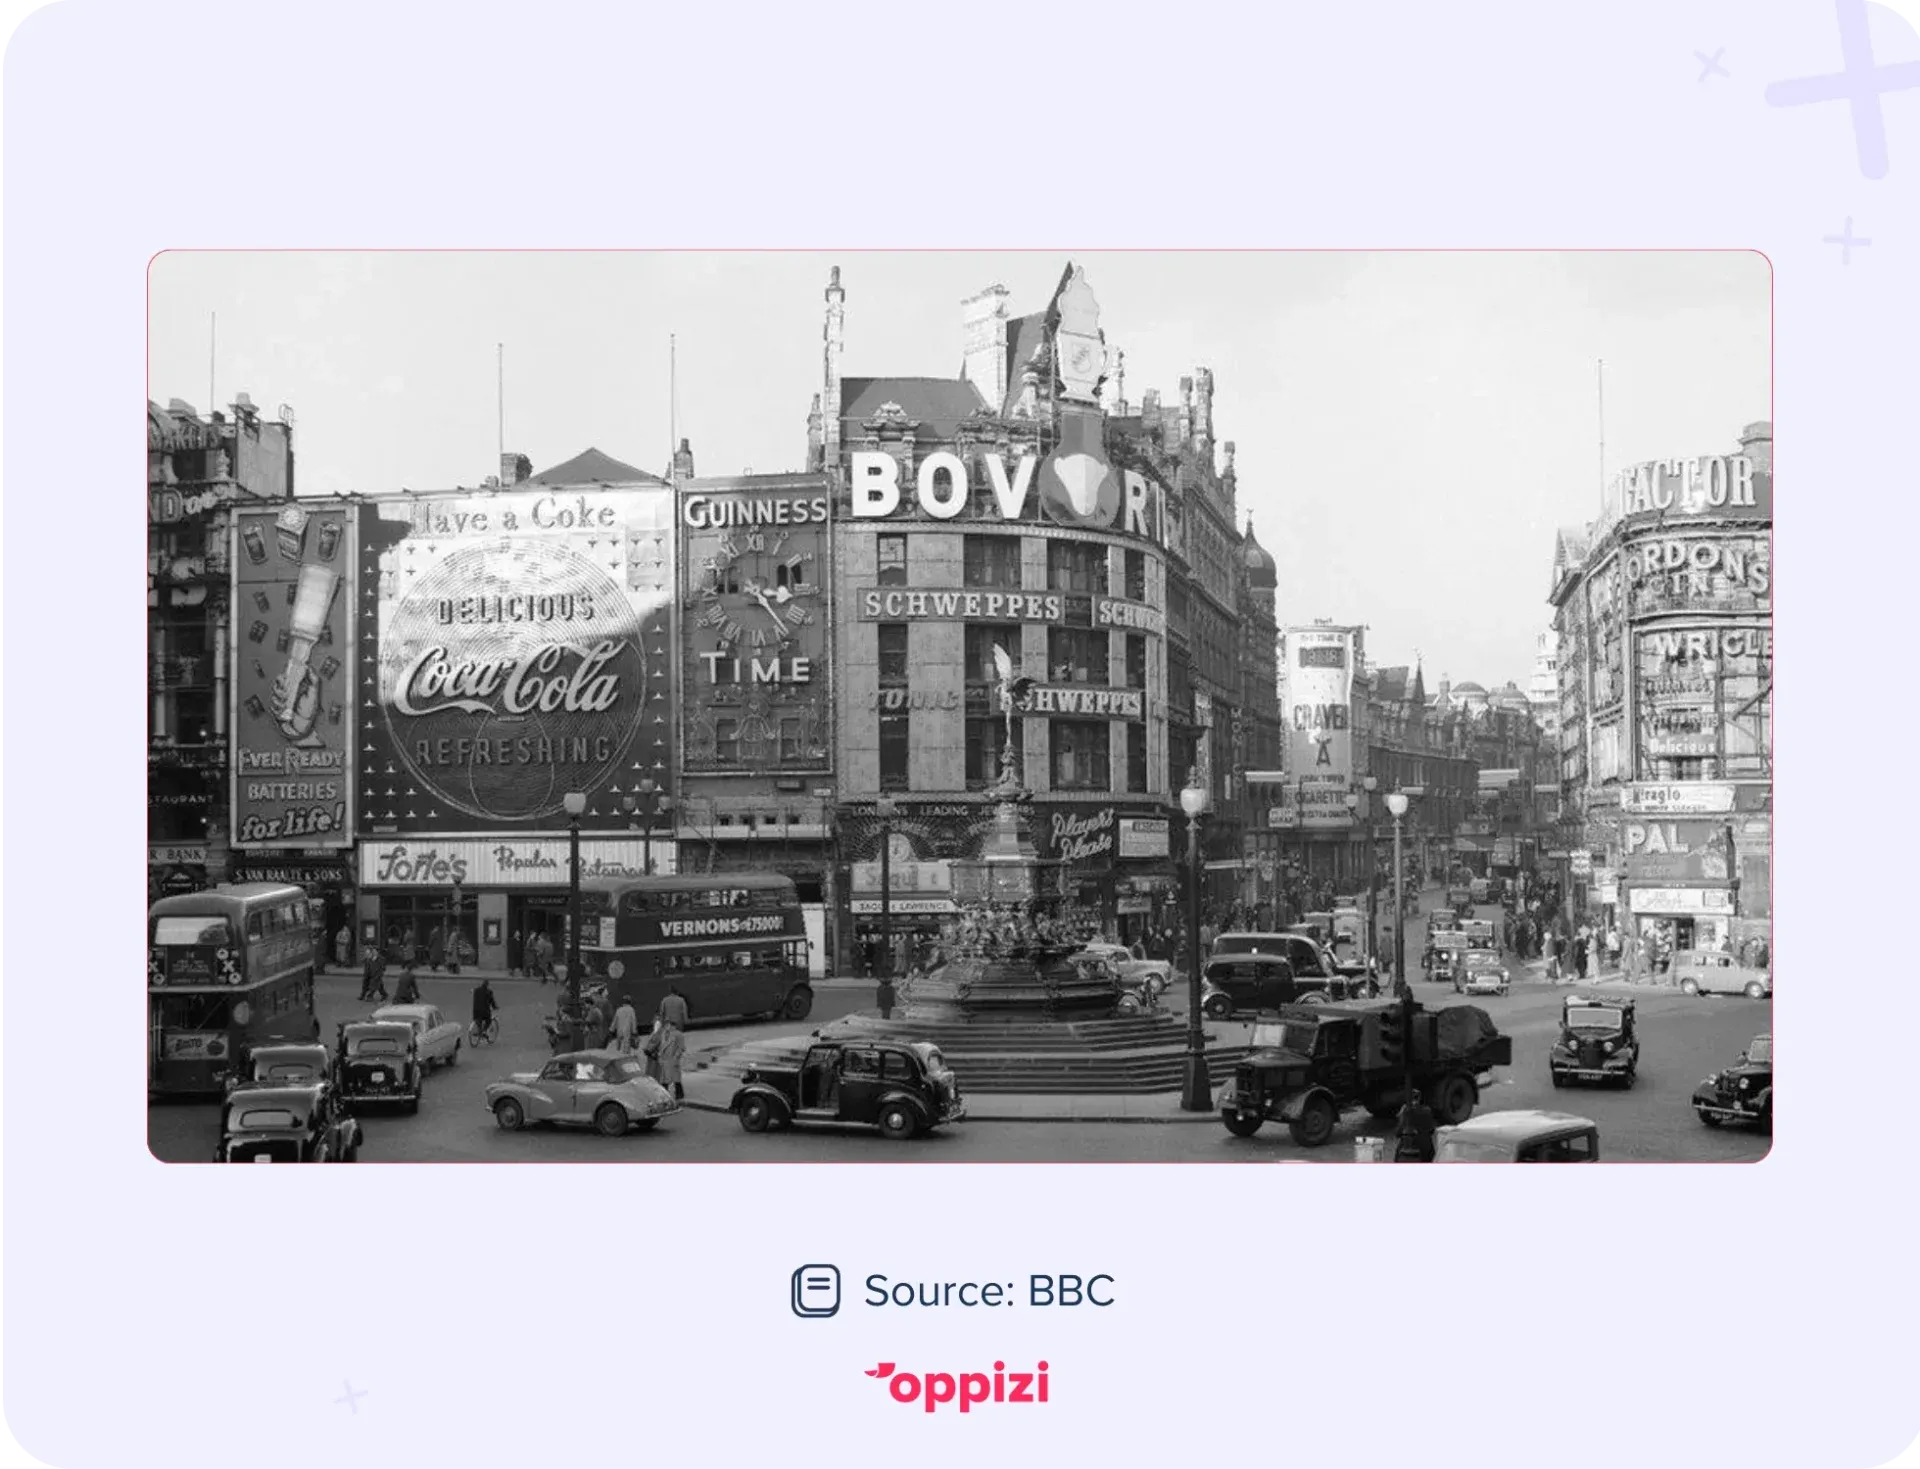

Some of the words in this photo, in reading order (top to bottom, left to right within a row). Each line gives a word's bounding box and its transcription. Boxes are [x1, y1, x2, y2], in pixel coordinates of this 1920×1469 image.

[503, 510, 519, 531] a
[531, 496, 616, 530] Coke
[683, 496, 827, 528] GUINNESS
[438, 593, 597, 626] DELICIOUS
[864, 591, 1061, 621] SCHWEPPES
[699, 651, 810, 685] TIME
[283, 749, 343, 775] READY
[414, 735, 612, 766] REFRESHING
[247, 782, 338, 802] BATTERIES
[241, 815, 282, 842] for
[283, 801, 346, 837] life!
[920, 805, 969, 817] LEADING
[1625, 823, 1689, 854] PAL
[377, 846, 468, 882] Forte's
[492, 845, 558, 873] Popular
[660, 917, 740, 937] VERNONS
